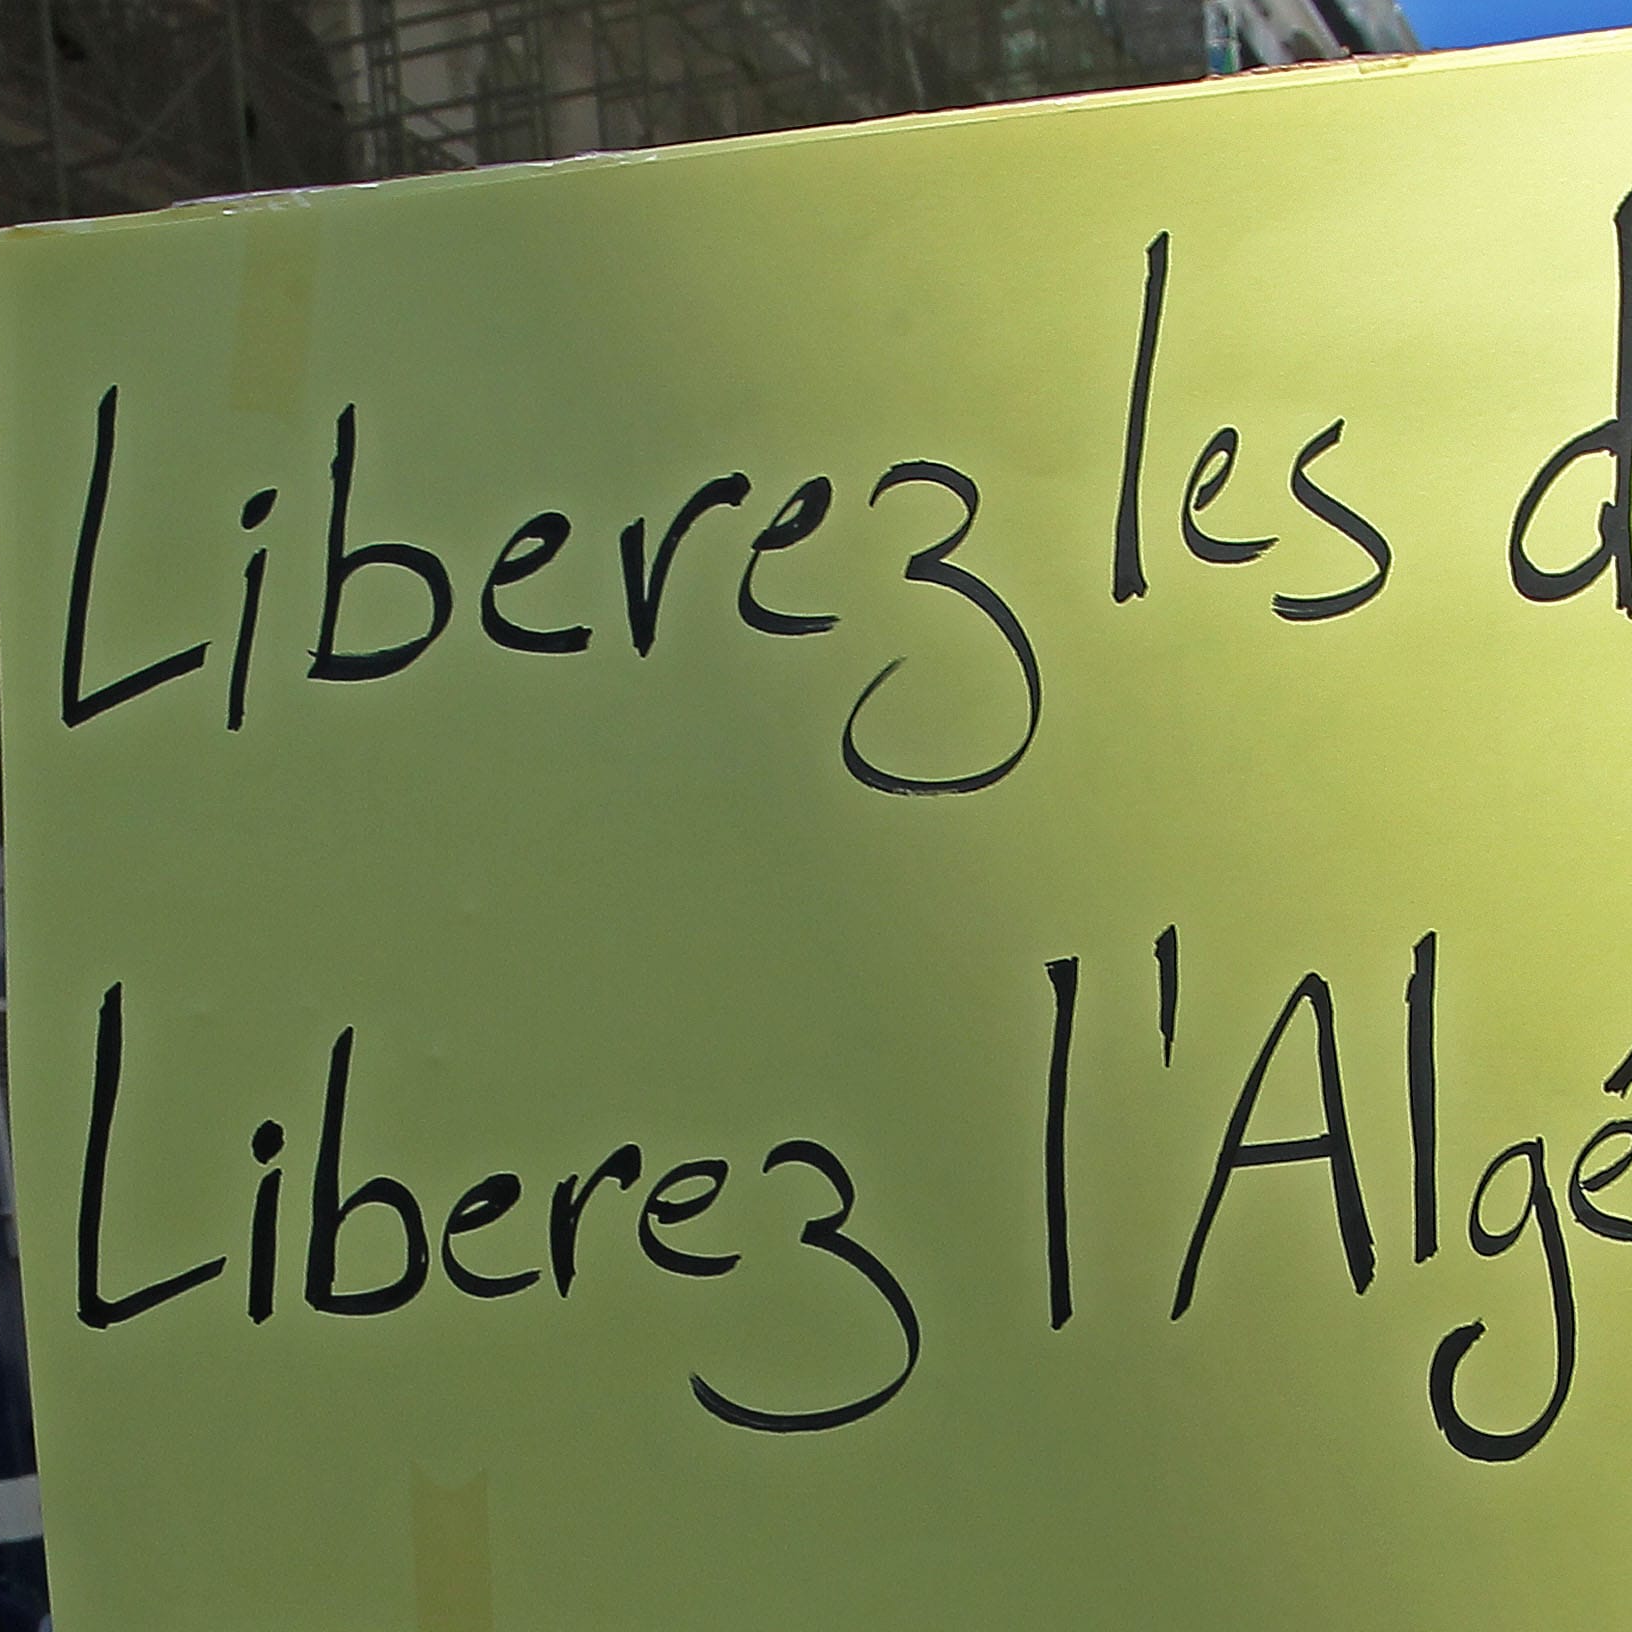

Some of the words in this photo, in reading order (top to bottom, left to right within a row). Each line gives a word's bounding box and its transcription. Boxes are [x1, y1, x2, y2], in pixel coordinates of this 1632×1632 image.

[62, 384, 1041, 796] Liberez
[1112, 230, 1393, 623] les
[76, 980, 922, 1435] Liberez
